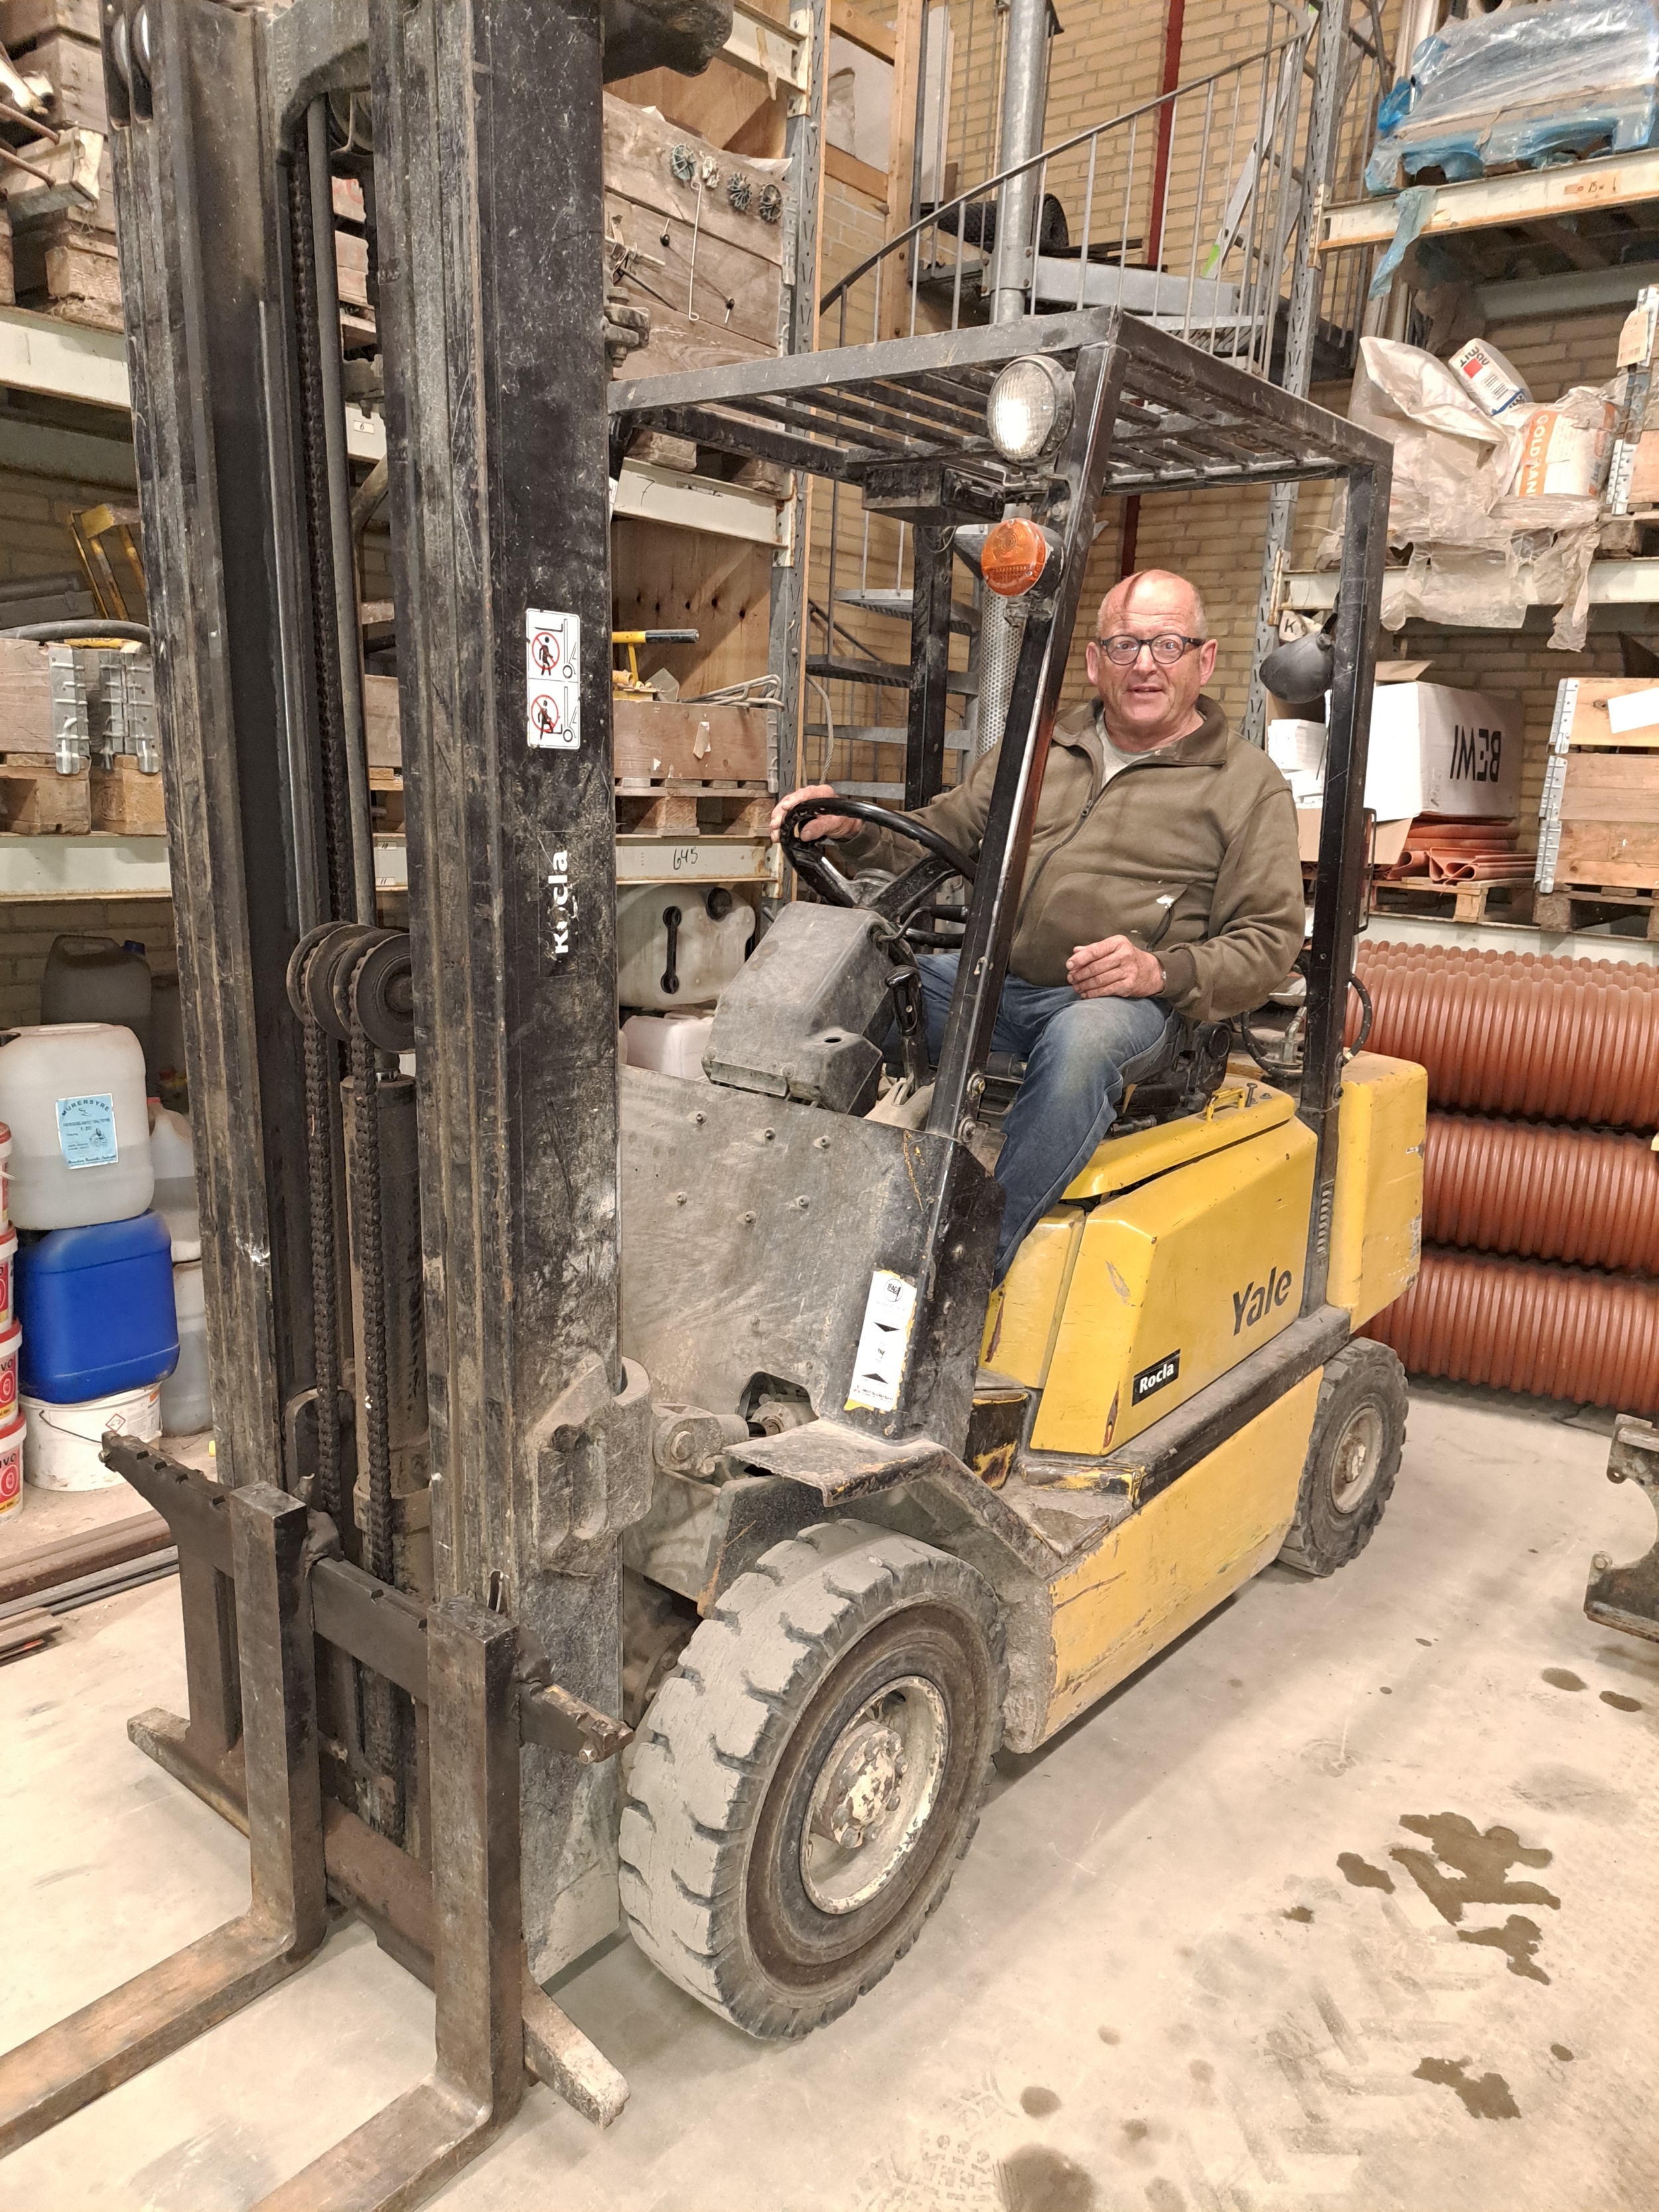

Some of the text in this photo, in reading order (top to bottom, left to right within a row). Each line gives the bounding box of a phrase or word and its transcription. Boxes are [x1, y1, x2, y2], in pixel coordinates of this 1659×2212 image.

[360, 422, 364, 431] 6
[636, 475, 655, 506] 7
[1284, 619, 1296, 633] K
[673, 846, 698, 870] 645
[62, 1099, 109, 1116] MURERSYRE
[1233, 1266, 1292, 1337] Yale
[1139, 1363, 1174, 1394] Rocla
